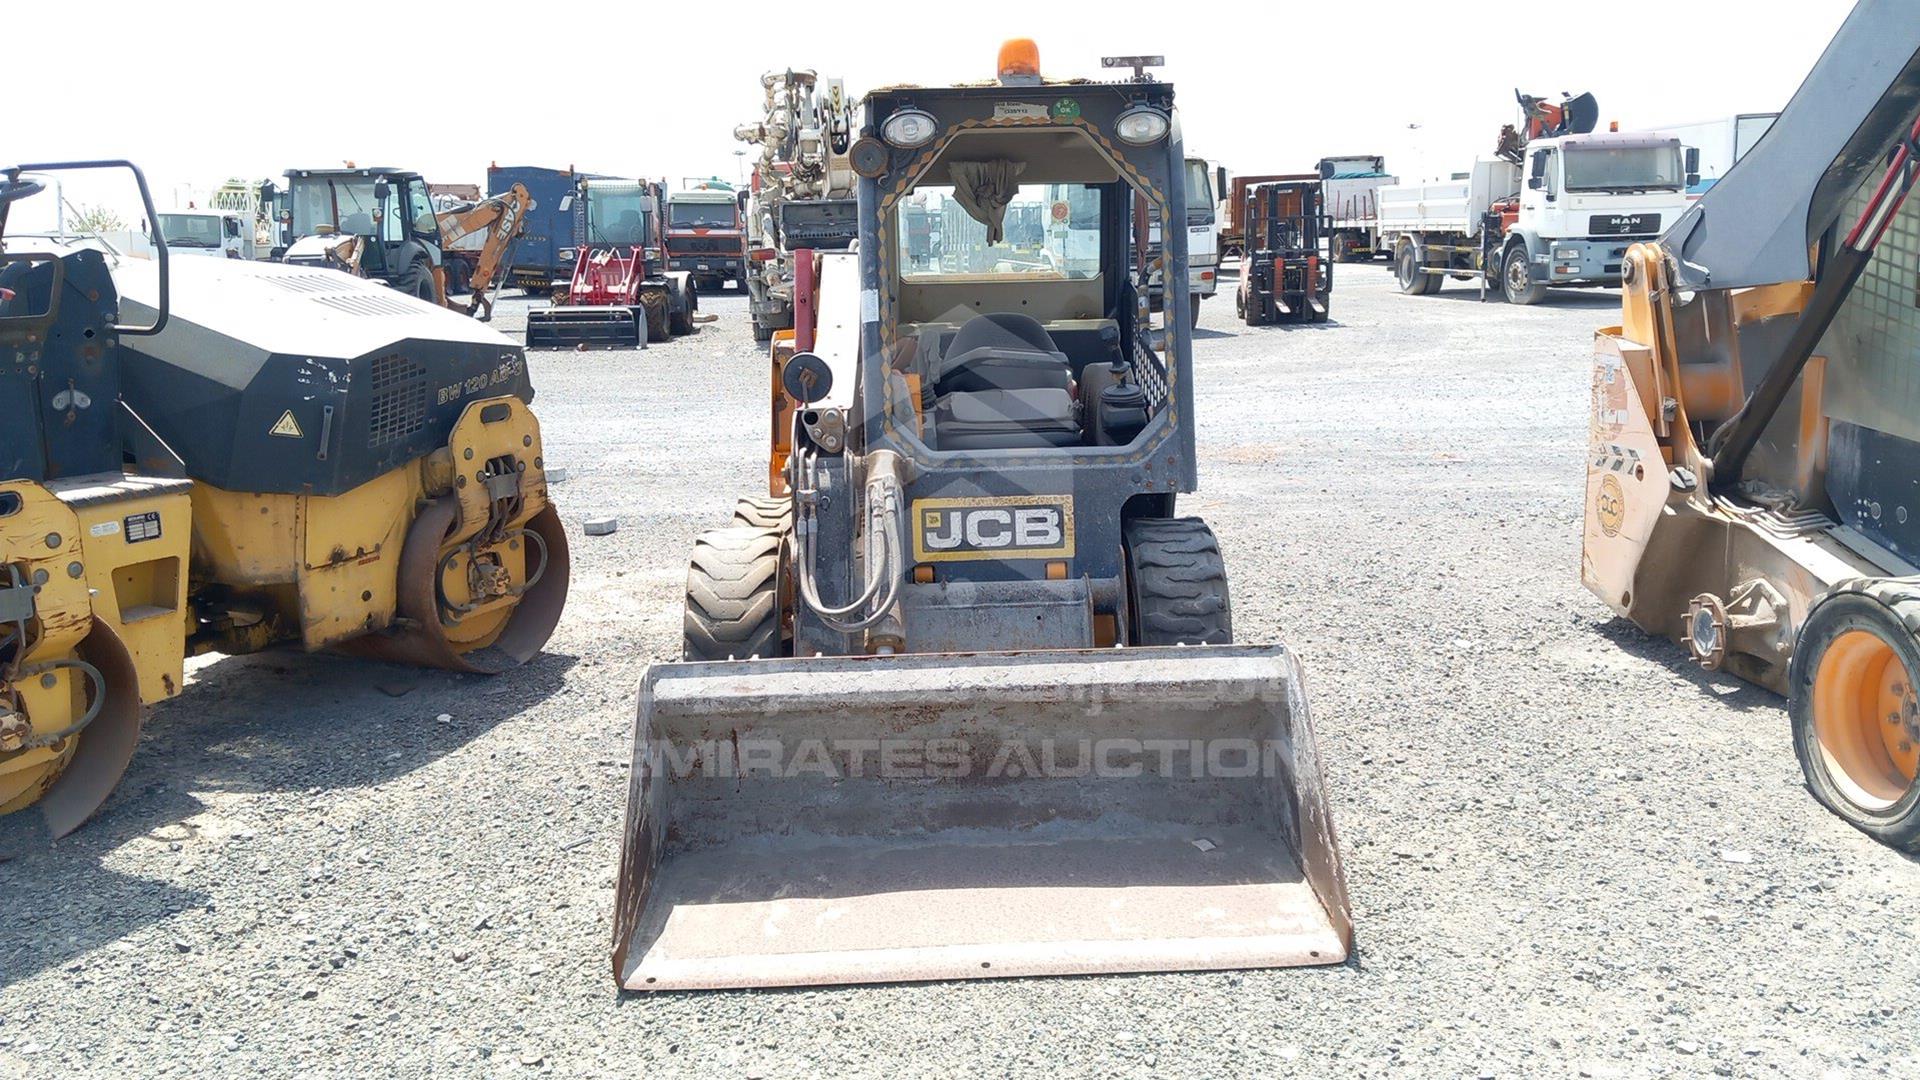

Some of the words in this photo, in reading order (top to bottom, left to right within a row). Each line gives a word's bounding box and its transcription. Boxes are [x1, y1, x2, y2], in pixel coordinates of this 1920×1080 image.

[496, 198, 521, 241] CASE
[1610, 216, 1641, 225] MAN
[437, 381, 463, 405] BW
[464, 373, 488, 394] 120
[925, 508, 1061, 548] JCB
